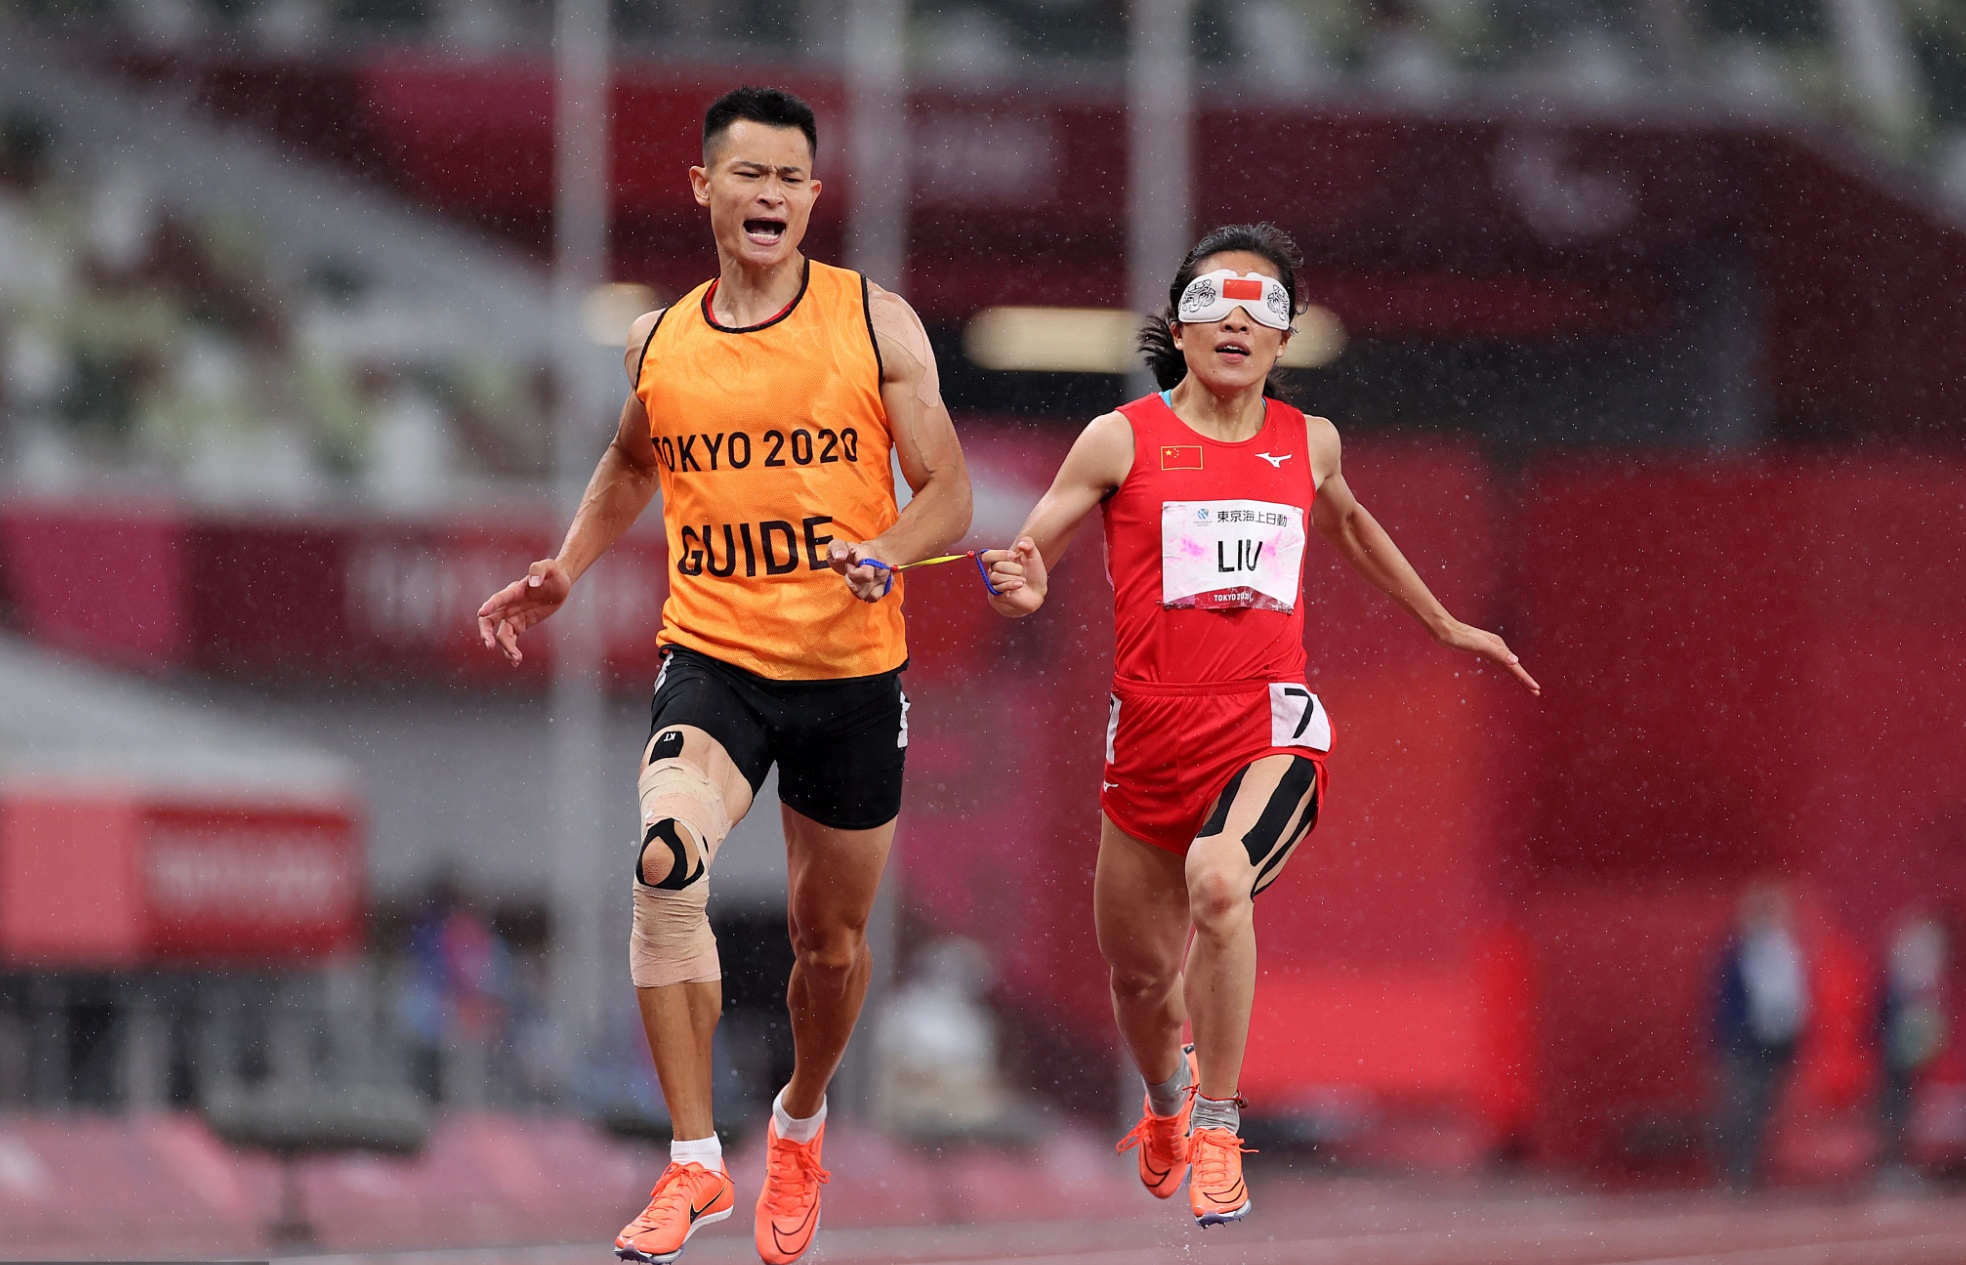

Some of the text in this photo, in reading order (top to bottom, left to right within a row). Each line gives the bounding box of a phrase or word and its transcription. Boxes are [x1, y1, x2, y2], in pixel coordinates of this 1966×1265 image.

[651, 427, 858, 473] TOKYO 2020
[1217, 510, 1288, 527] 東京海上日動
[677, 516, 833, 578] GUIDE
[1217, 539, 1263, 573] LIU
[1214, 593, 1236, 602] TOKYO
[1284, 687, 1314, 739] 7
